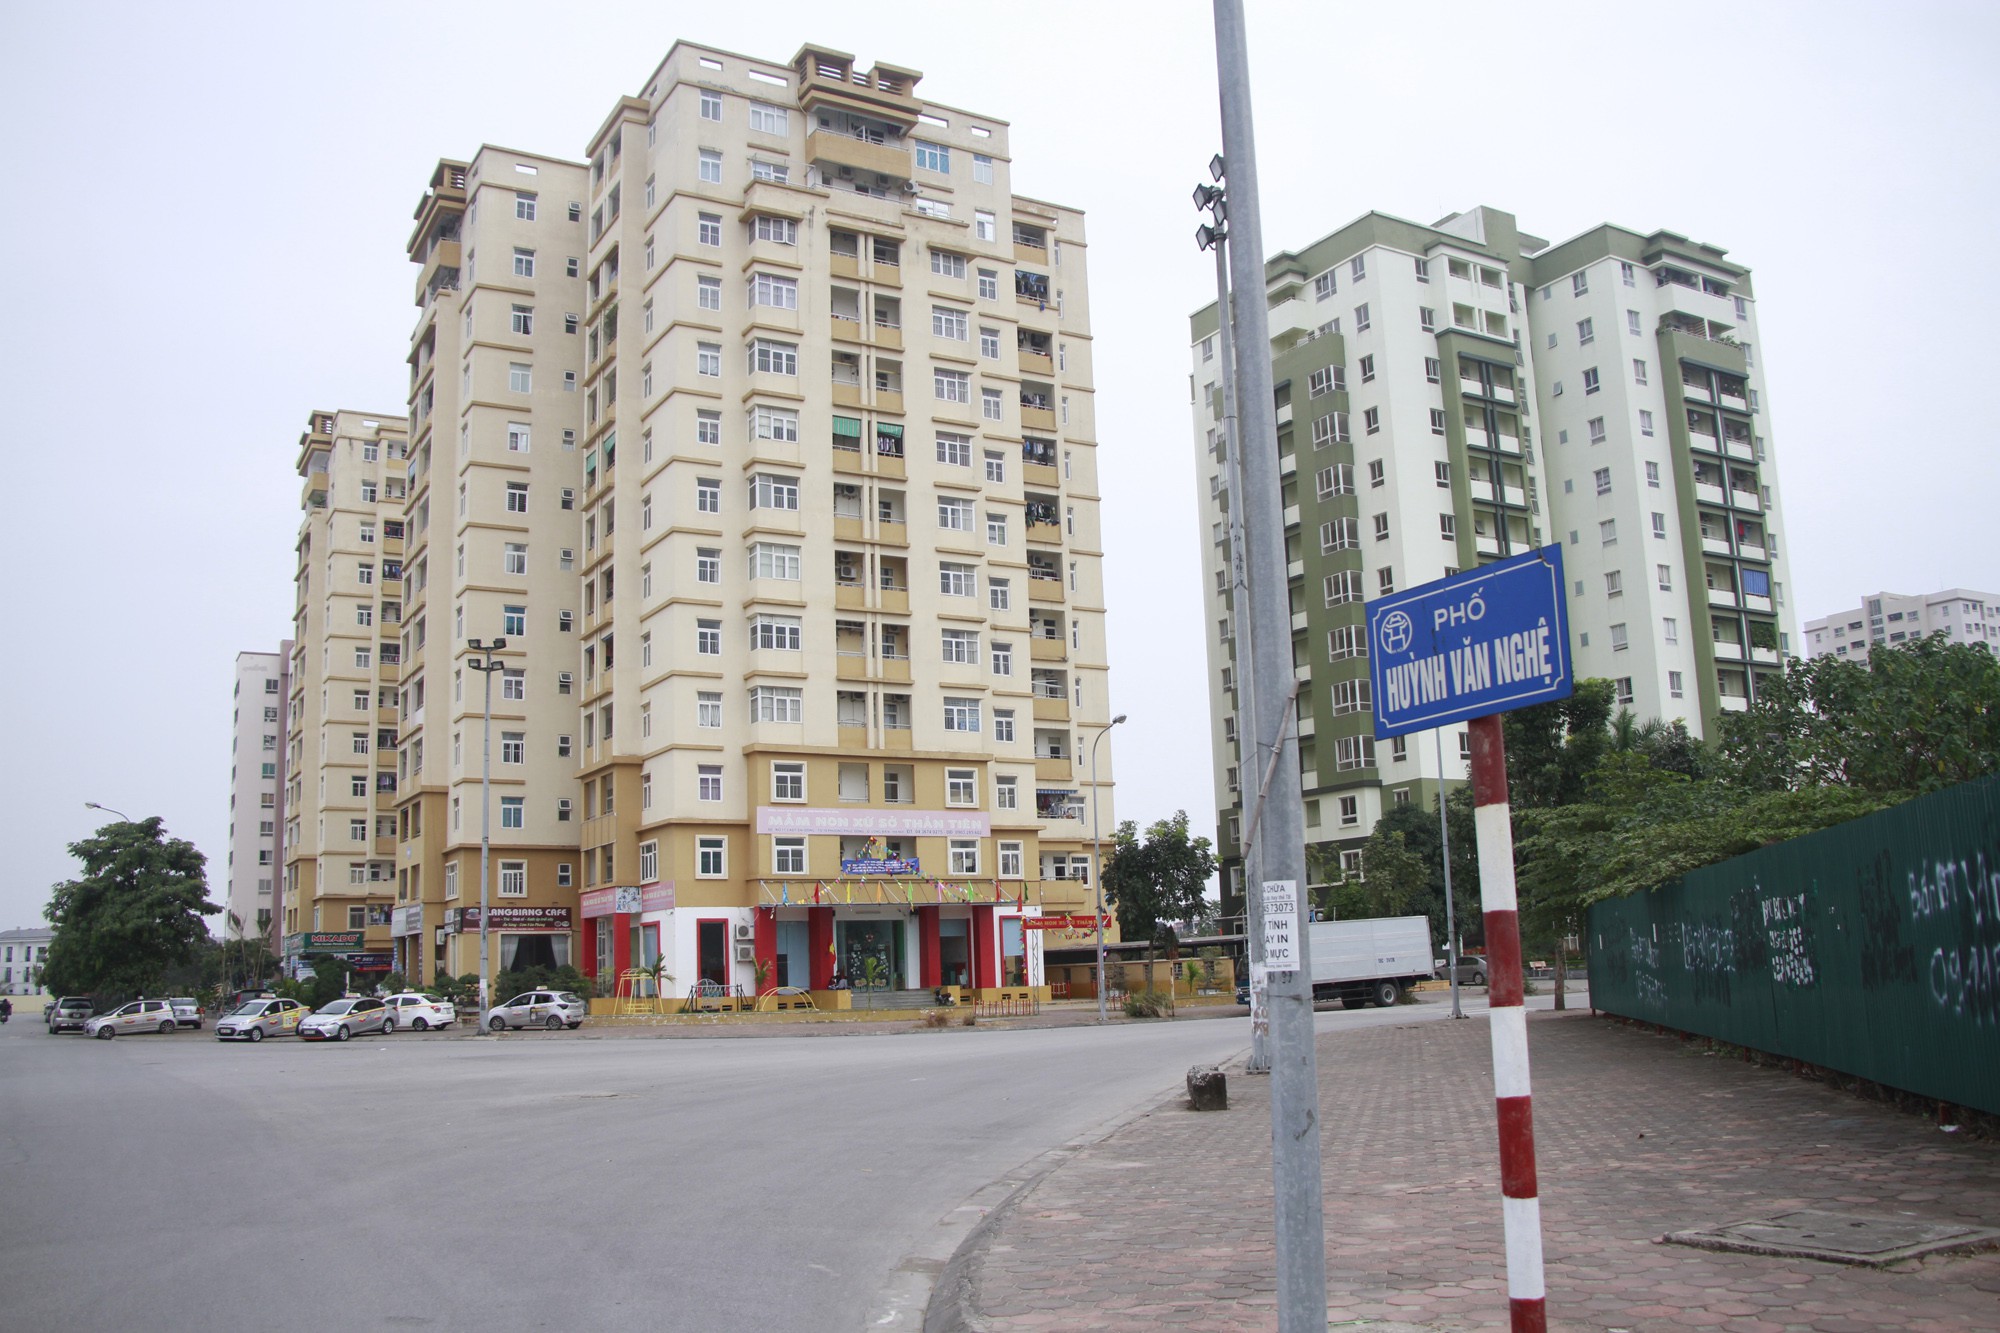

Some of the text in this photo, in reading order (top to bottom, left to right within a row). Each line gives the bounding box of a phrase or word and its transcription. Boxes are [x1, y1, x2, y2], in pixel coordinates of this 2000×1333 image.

[1434, 587, 1486, 631] PHỐ
[1386, 617, 1552, 712] HUỲNH VĂN NGHỆ
[815, 816, 849, 827] NON
[545, 908, 567, 916] CAFE
[1268, 917, 1288, 930] TÍNH
[311, 934, 358, 943] MIKADO
[1277, 934, 1289, 943] IN
[1269, 948, 1289, 961] MỰC
